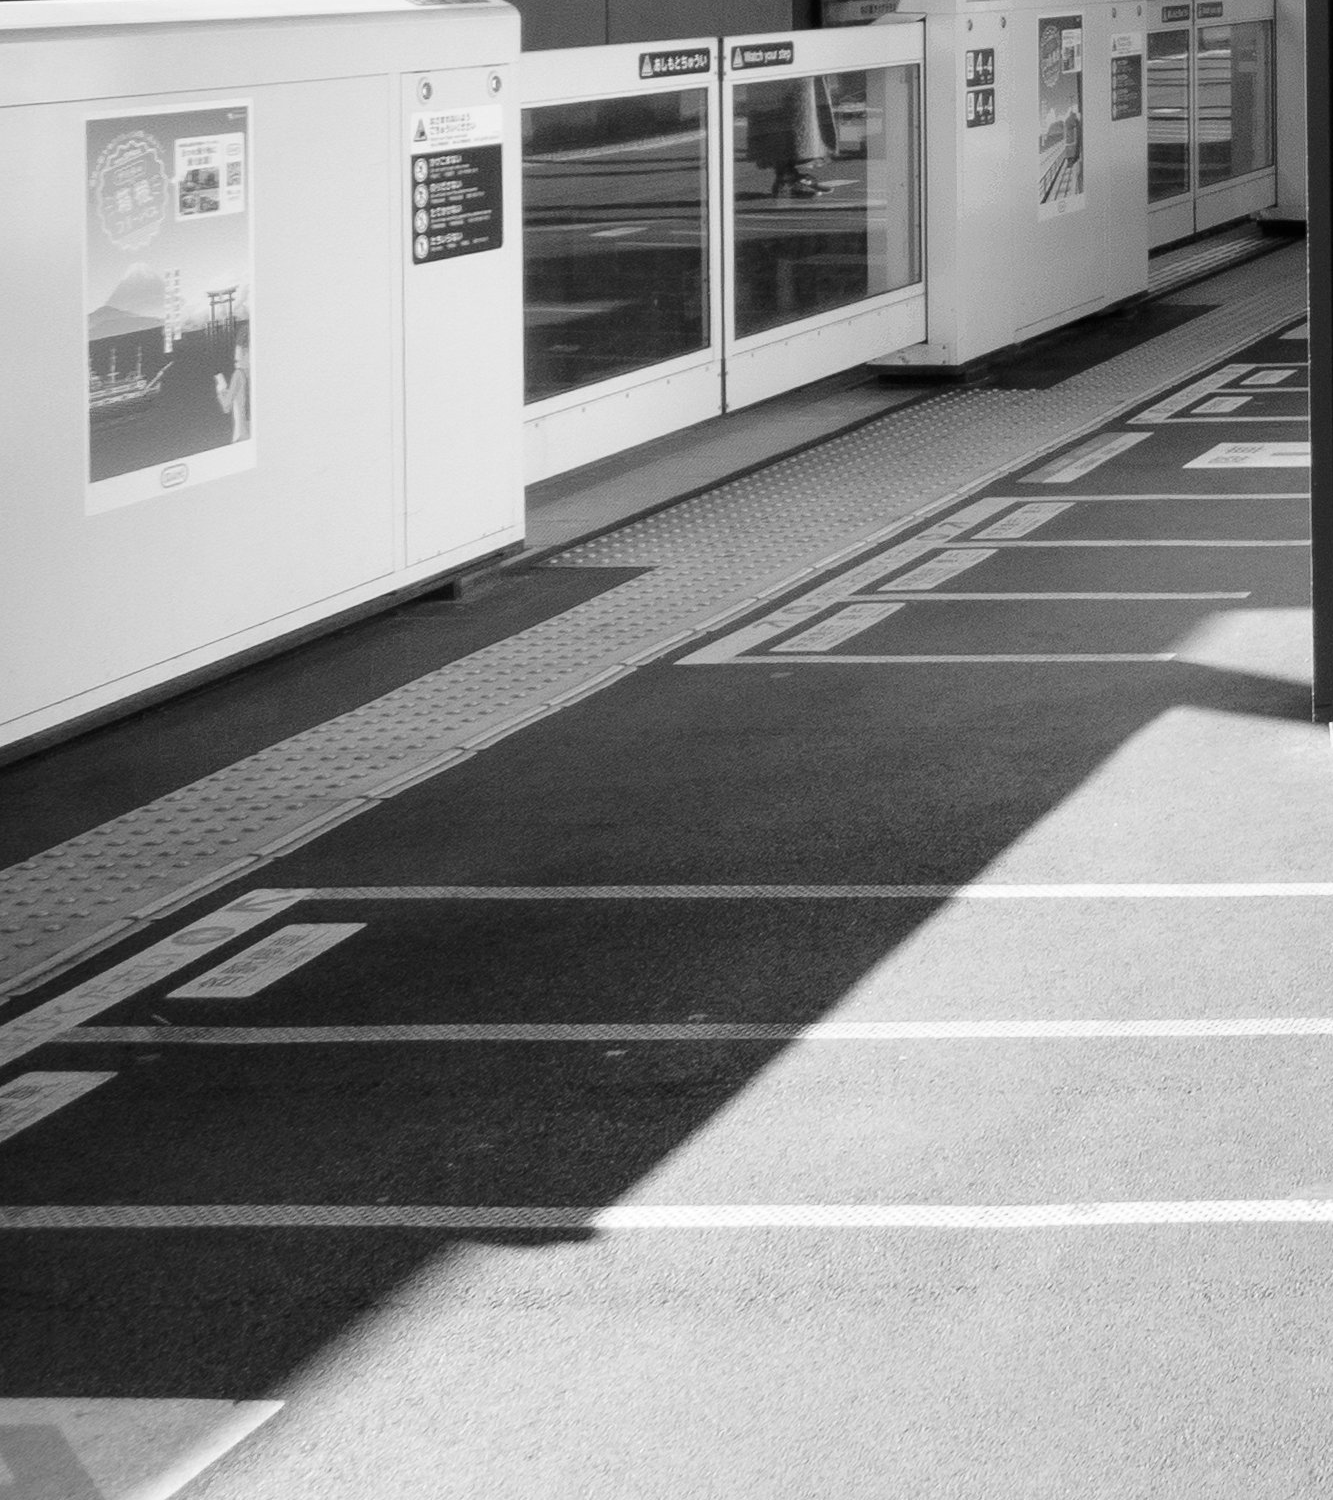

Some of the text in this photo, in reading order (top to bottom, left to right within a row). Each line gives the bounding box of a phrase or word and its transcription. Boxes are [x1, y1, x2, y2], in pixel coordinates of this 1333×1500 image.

[653, 54, 708, 73] あしもとちゅうい
